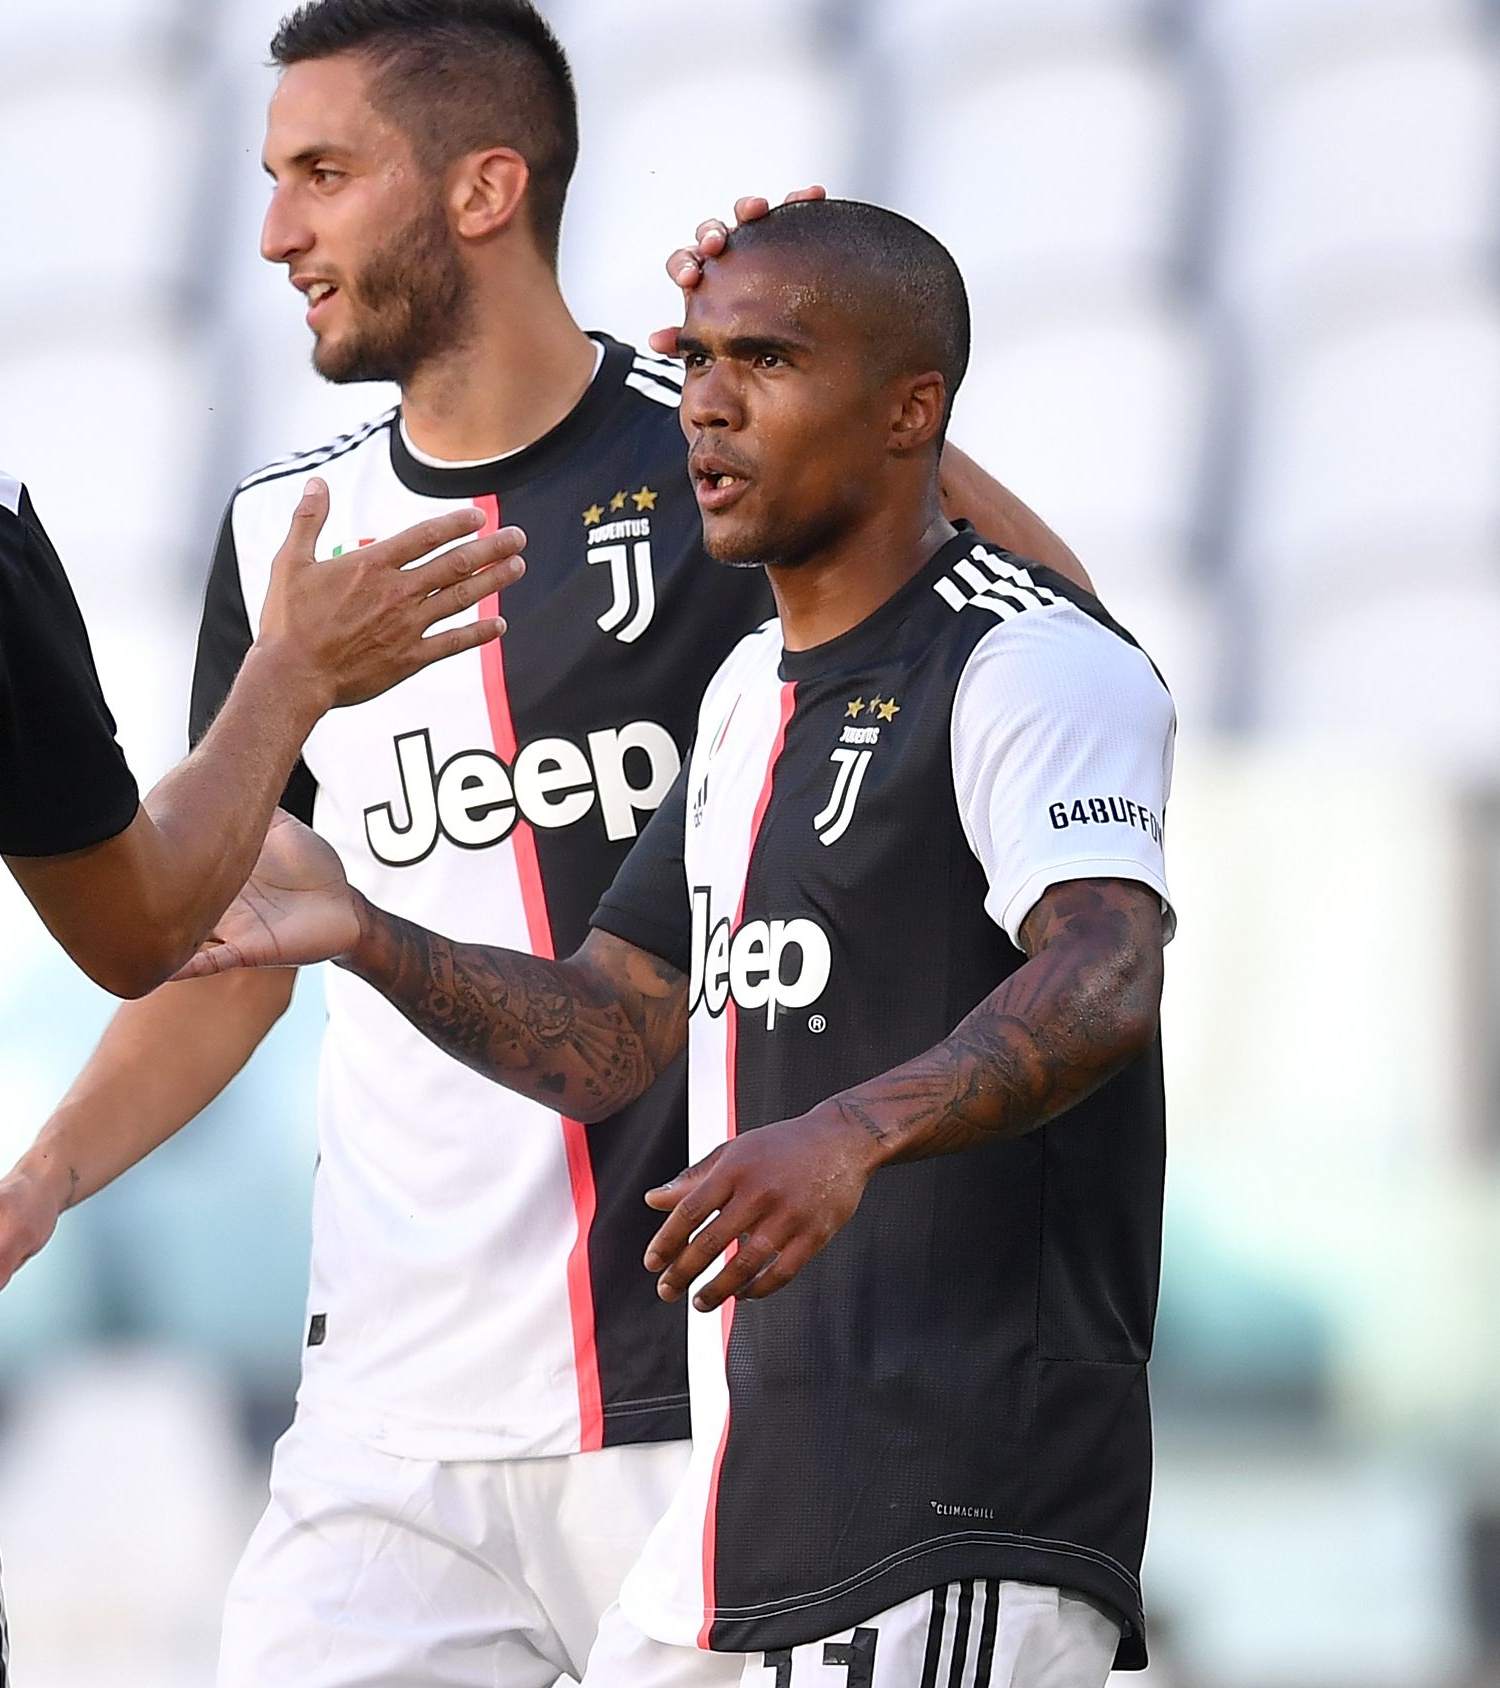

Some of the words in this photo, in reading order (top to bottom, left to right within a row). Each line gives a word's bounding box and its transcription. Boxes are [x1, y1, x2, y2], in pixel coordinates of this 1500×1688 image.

[587, 517, 651, 546] JUVENTUS
[363, 720, 681, 867] Jeep
[688, 884, 833, 1032] Jeep
[936, 1503, 995, 1519] CLIMACHILL
